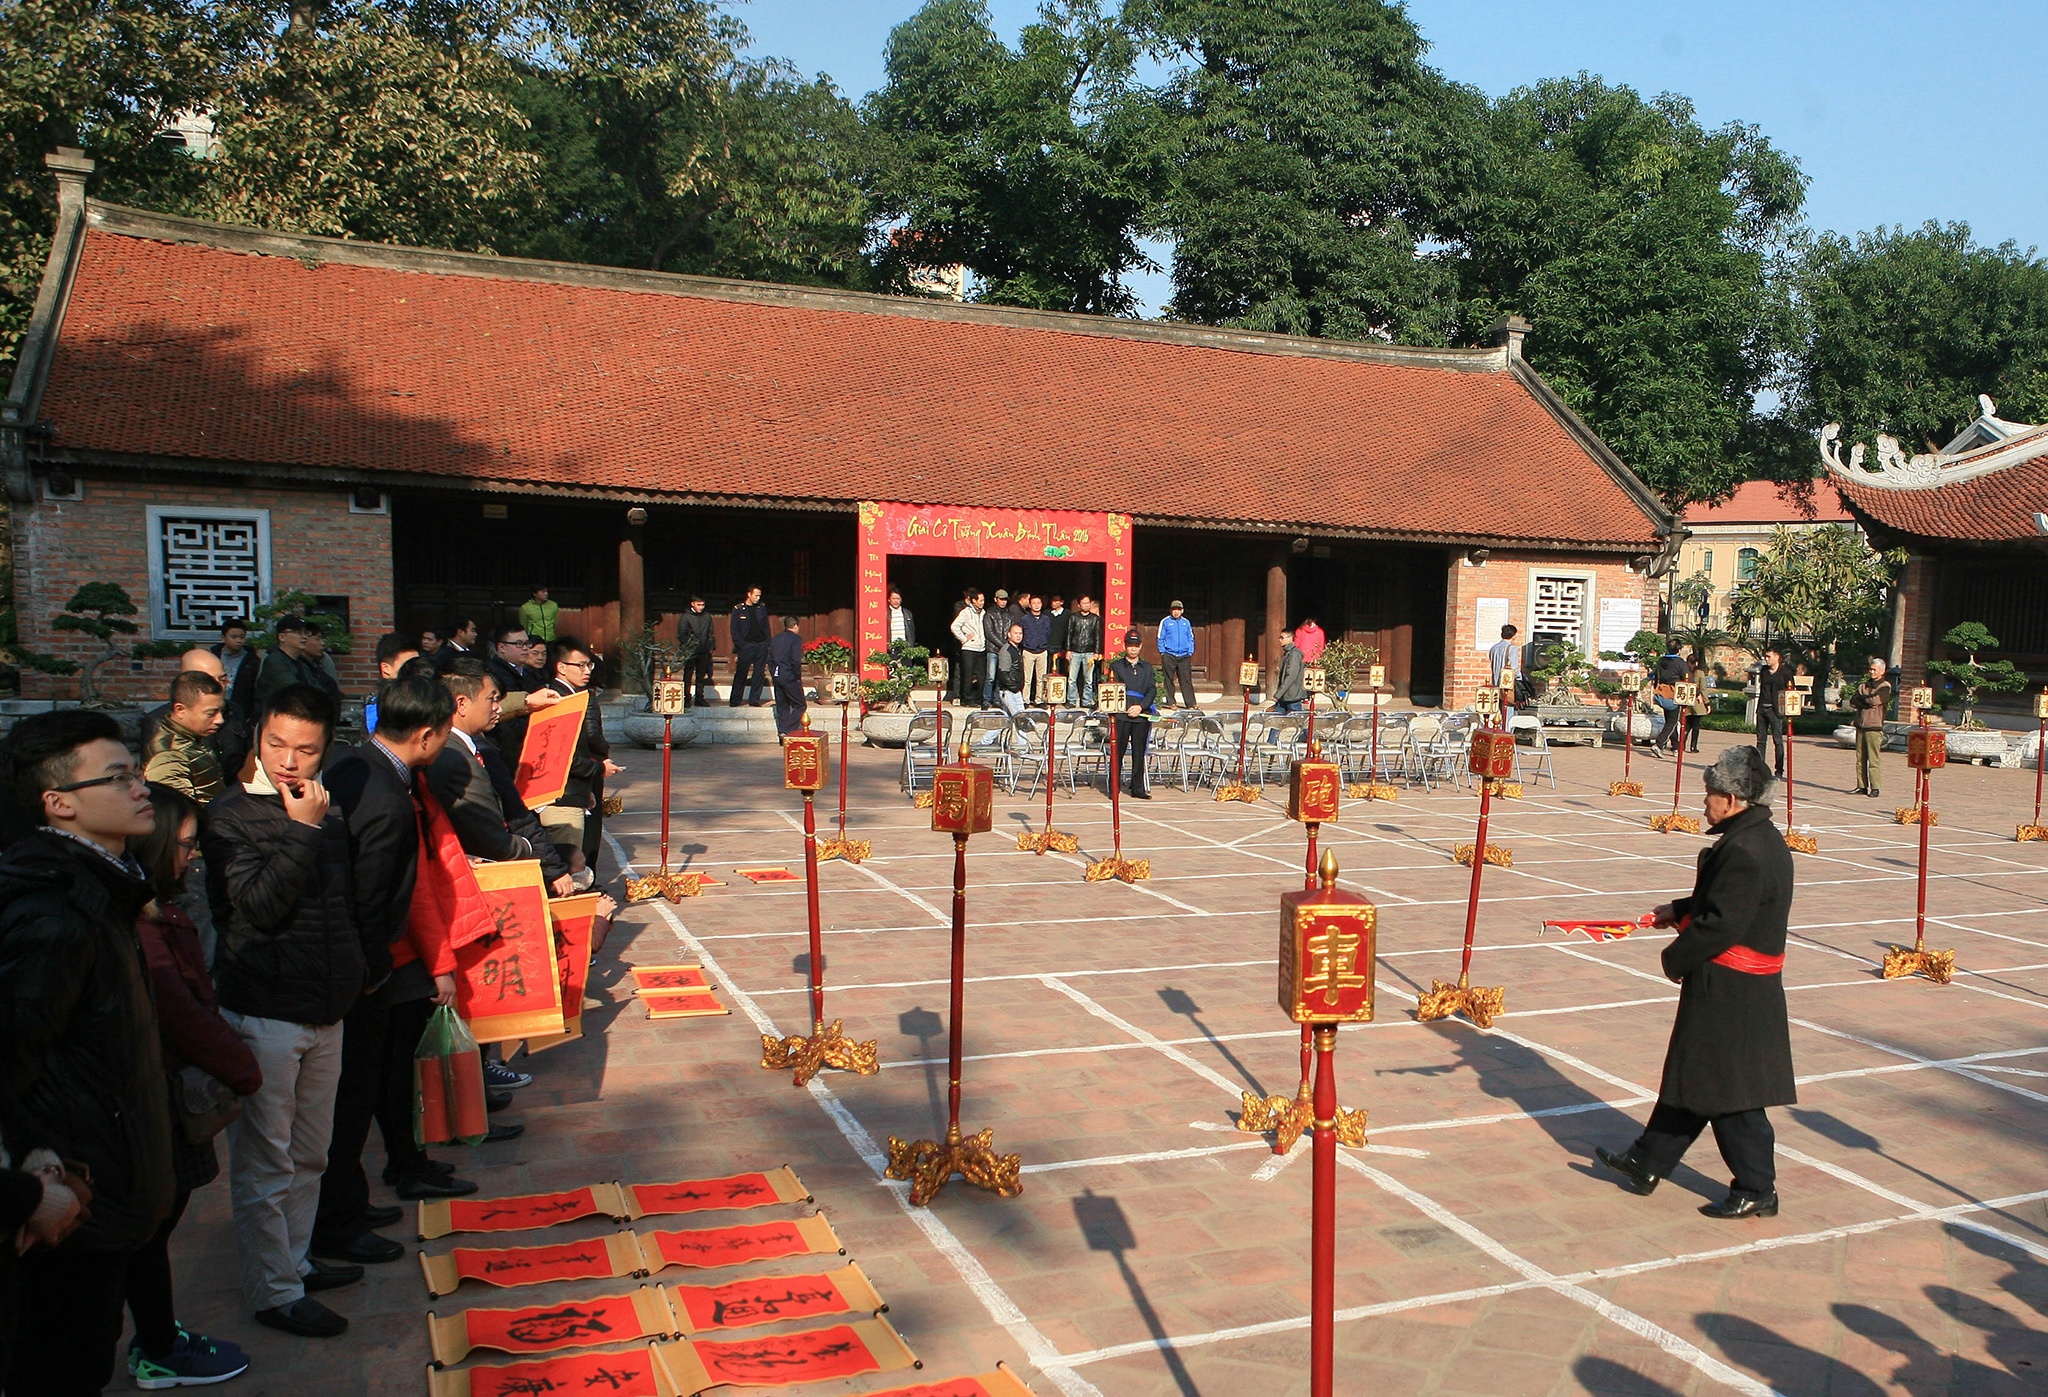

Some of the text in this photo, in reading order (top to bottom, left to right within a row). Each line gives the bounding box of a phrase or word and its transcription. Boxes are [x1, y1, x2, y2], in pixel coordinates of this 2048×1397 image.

[907, 515, 930, 538] Giải
[981, 520, 1015, 540] Xuân
[1042, 522, 1071, 544] Thân
[1073, 529, 1089, 543] 2016
[1052, 682, 1064, 698] 馬
[936, 780, 968, 820] 馬
[1303, 924, 1366, 1006] 車
